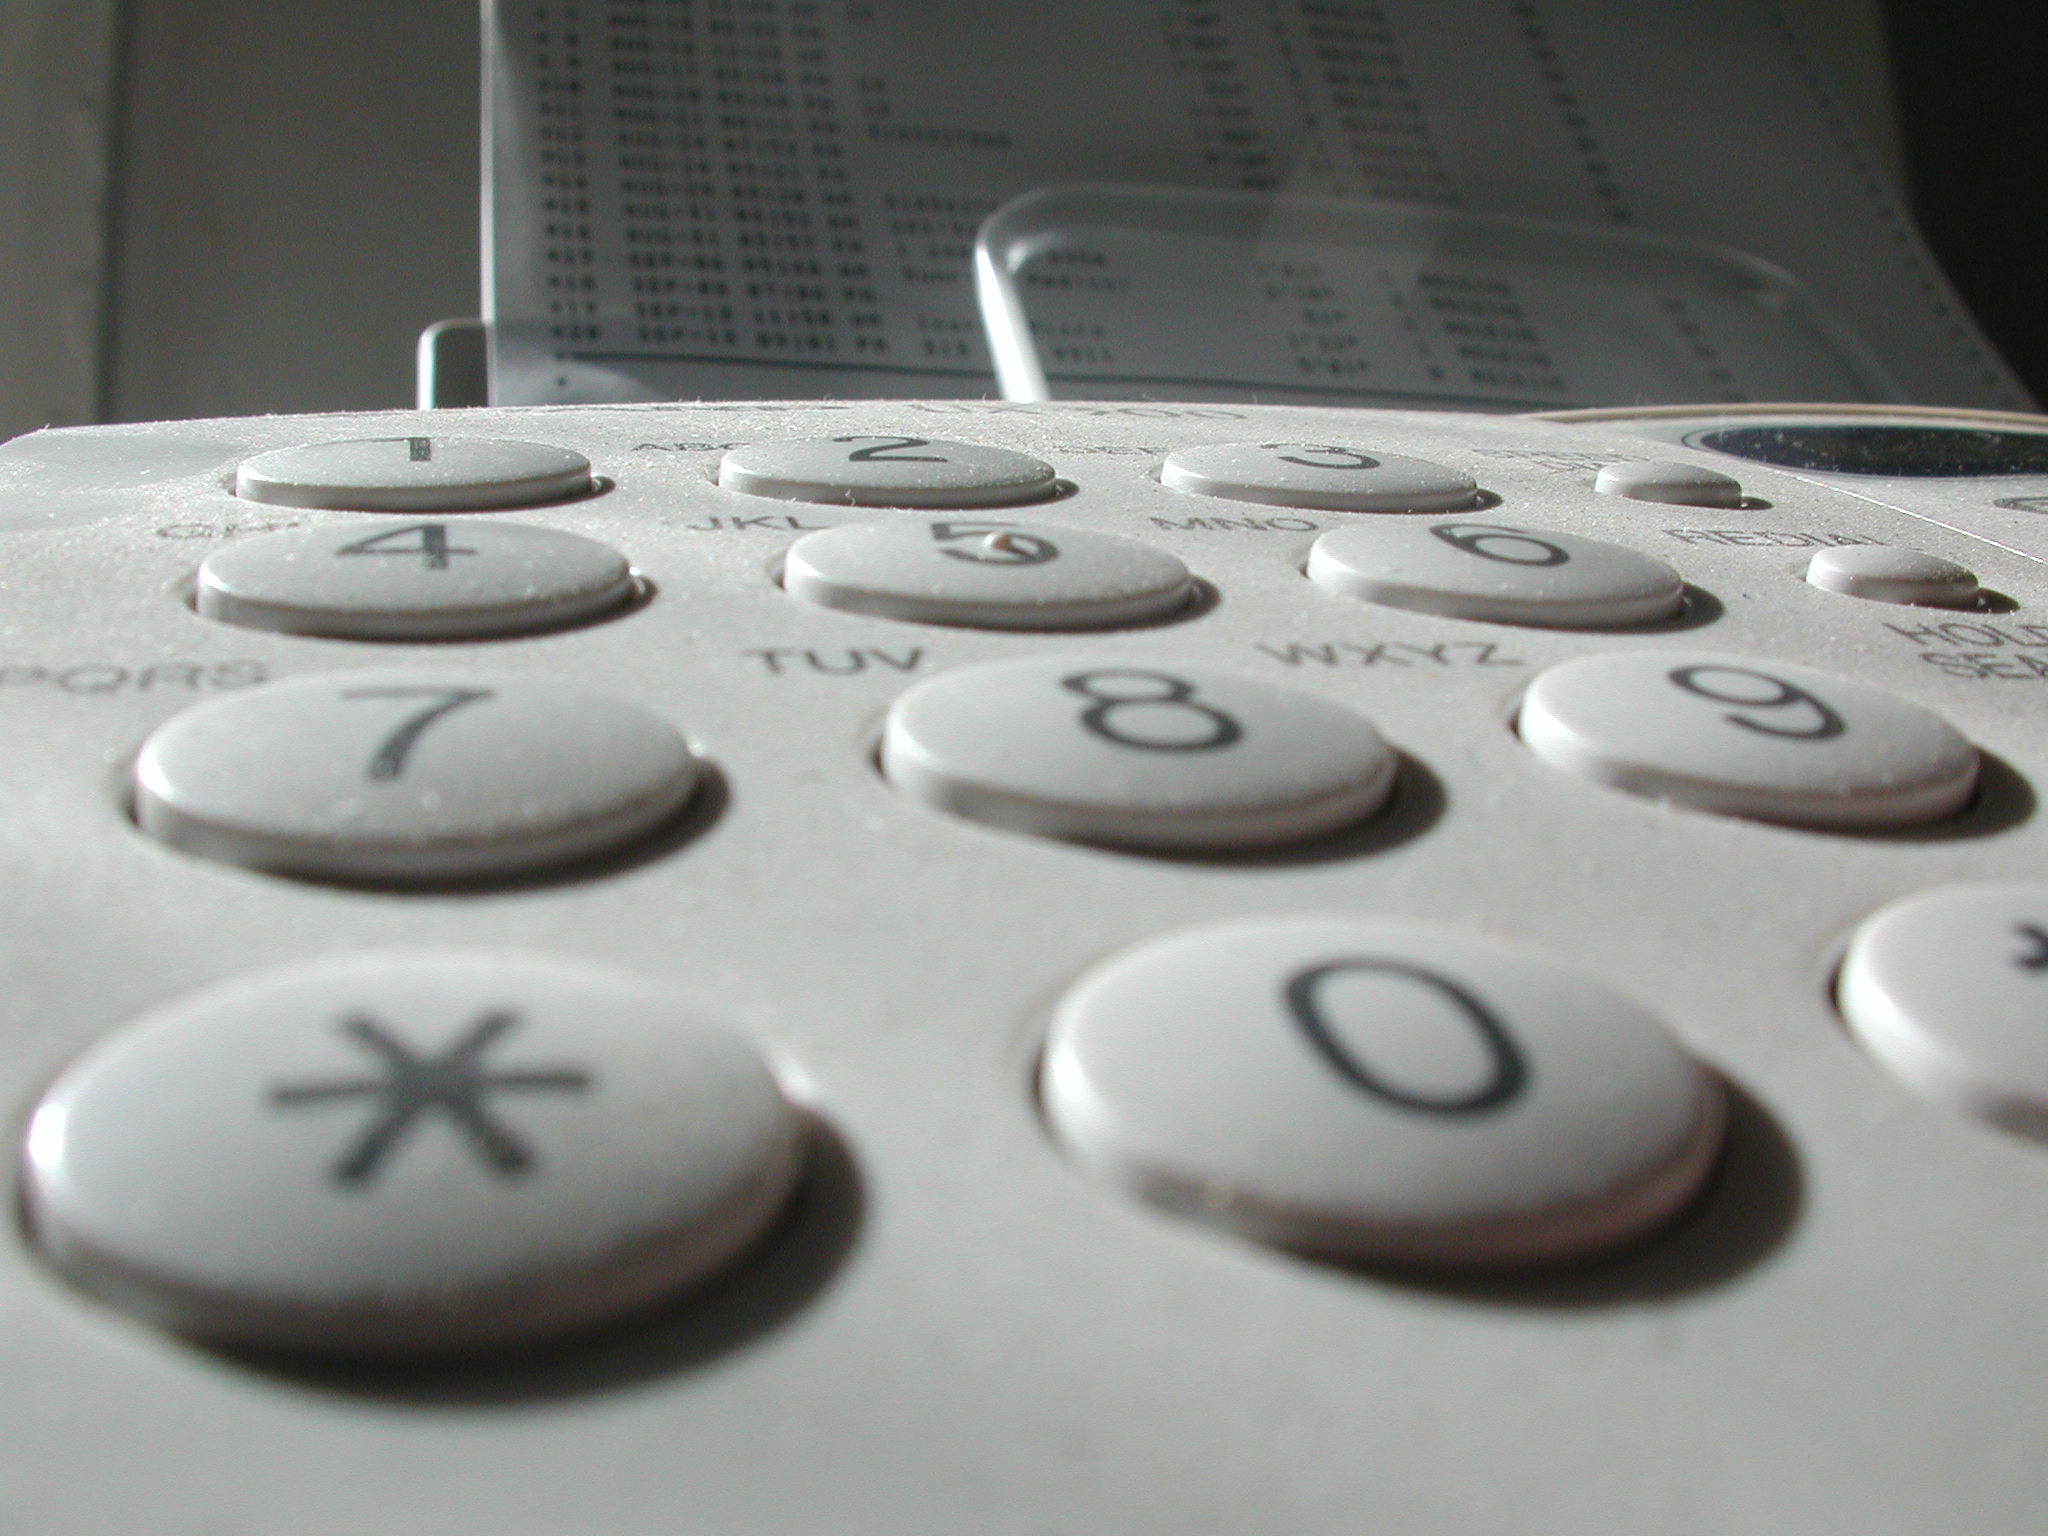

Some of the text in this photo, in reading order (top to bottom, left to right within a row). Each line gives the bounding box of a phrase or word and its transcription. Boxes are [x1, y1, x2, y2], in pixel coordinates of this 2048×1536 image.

[834, 435, 948, 462] 2
[1260, 444, 1380, 469] 3
[686, 515, 832, 531] JKL
[932, 522, 1060, 565] 5
[1150, 517, 1319, 532] MNO
[1429, 522, 1570, 567] 6
[337, 524, 477, 569] 4
[743, 646, 927, 676] TUV
[1256, 641, 1523, 668] WXYZ
[1060, 667, 1245, 753] 8
[1669, 664, 1847, 741] 9
[338, 688, 496, 781] 7
[1283, 953, 1531, 1118] 0
